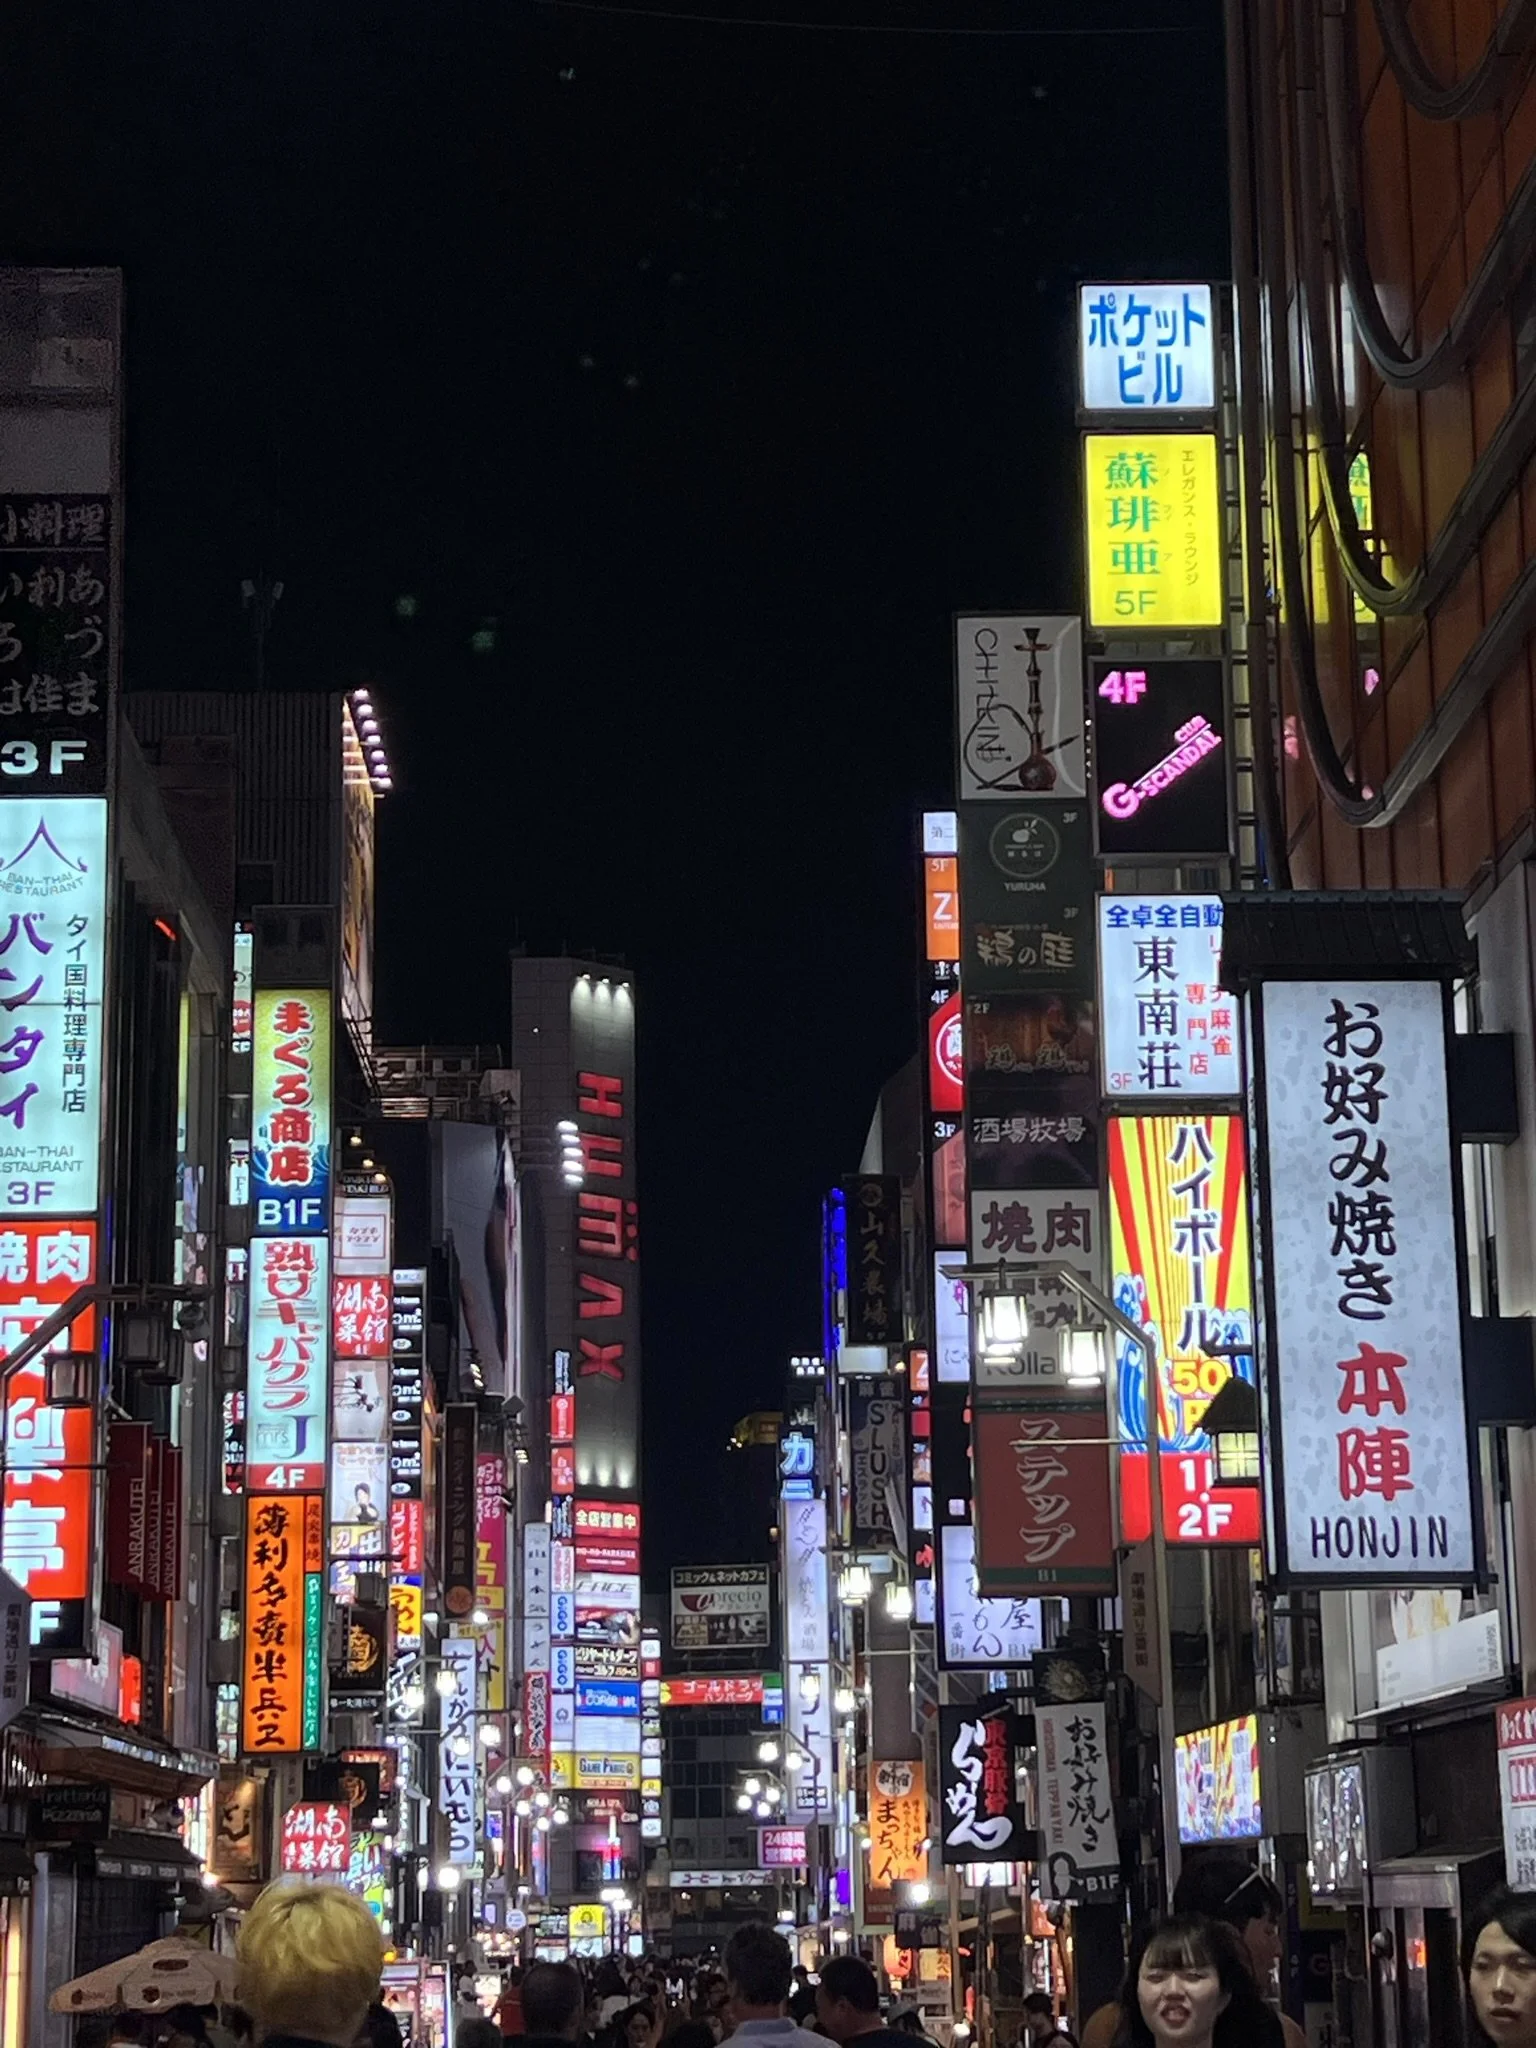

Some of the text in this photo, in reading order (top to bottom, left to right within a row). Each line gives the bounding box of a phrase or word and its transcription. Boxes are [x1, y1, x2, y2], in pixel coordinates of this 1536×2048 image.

[1089, 293, 1206, 347] ポケット
[1119, 351, 1183, 405] ビル
[1114, 591, 1157, 615] 5F
[1099, 672, 1146, 704] 4F
[0, 740, 88, 775] 3F
[1107, 903, 1225, 928] 全卓全自動
[62, 914, 88, 1113] タイ国料理専門店
[1133, 935, 1183, 1090] 東南荘
[1185, 983, 1208, 1076] 専門店
[972, 1117, 1086, 1143] 酒場牧場
[1321, 999, 1398, 1320] お好み焼き
[7, 1181, 55, 1204] 3F
[258, 1199, 321, 1225] B1F
[0, 1230, 91, 1284] 焼肉
[1168, 1122, 1223, 1352] ハイボール
[1335, 1342, 1415, 1501] 本陣
[265, 1465, 305, 1490] 4F
[1013, 1418, 1077, 1563] ステップ
[128, 1477, 145, 1583] ANRAKUTEI
[1178, 1504, 1234, 1536] 2F
[1311, 1516, 1449, 1560] HONJIN
[1085, 1873, 1120, 1892] B1F
